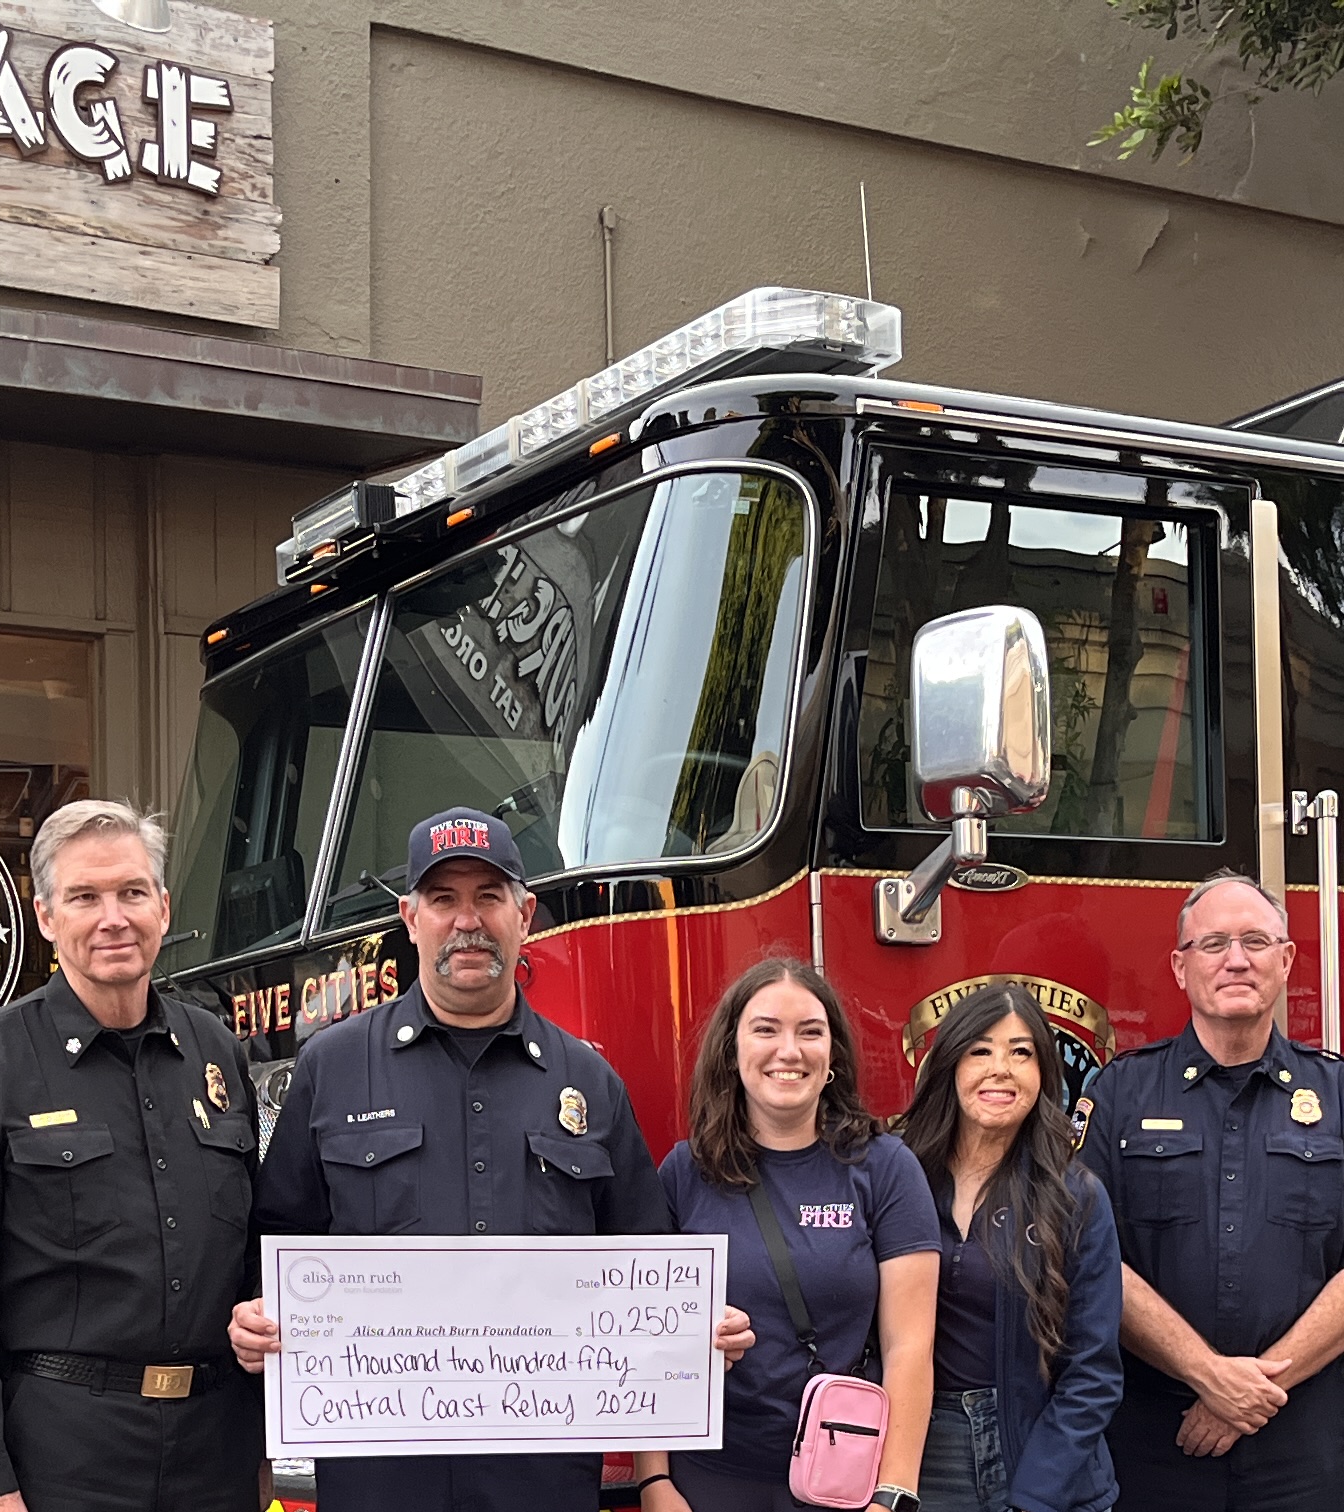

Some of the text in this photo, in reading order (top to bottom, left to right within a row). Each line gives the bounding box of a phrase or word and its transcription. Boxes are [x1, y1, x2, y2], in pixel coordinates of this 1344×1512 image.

[431, 827, 490, 855] FIRE
[231, 957, 399, 1039] FIVE CITIES
[1008, 979, 1088, 1020] ITIES
[357, 1108, 396, 1122] LEATHERS
[799, 1211, 853, 1228] FIRE
[302, 1271, 402, 1284] alisa ann ruch
[576, 1258, 700, 1291] Date 10/10/24
[290, 1313, 344, 1325] Pay to the
[290, 1328, 334, 1337] Order of
[353, 1325, 552, 1337] Alisa Ann Ruch Burn Foundation
[287, 1351, 333, 1376] Ten
[339, 1344, 440, 1377] thousand
[446, 1346, 484, 1373] two
[664, 1371, 699, 1380] Dollars
[300, 1382, 656, 1426] Central Coast Relay 2024
